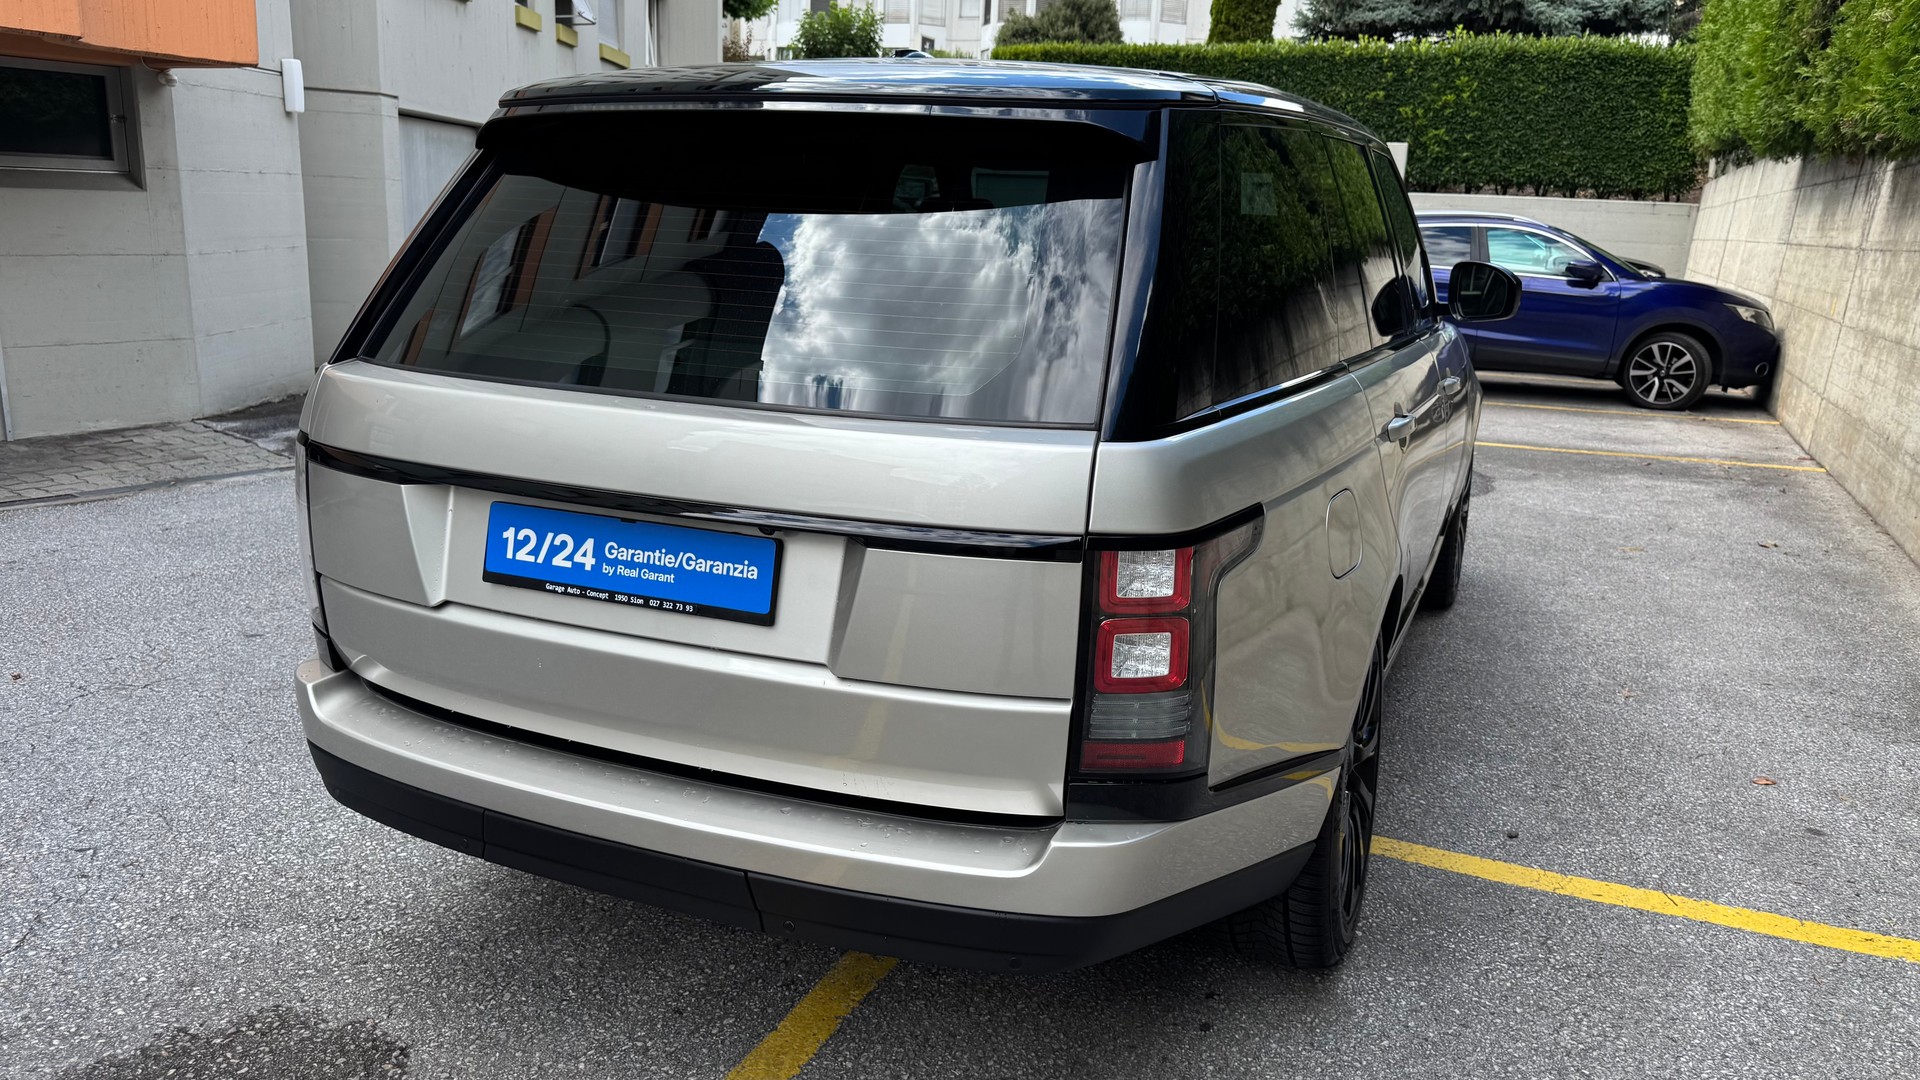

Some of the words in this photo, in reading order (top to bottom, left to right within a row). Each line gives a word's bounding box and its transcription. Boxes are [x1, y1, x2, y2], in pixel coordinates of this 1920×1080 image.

[502, 526, 596, 571] 12/24
[604, 541, 758, 580] Garantie/Garanzia
[602, 562, 616, 577] by
[616, 564, 639, 578] Real
[640, 568, 675, 584] Garant
[545, 582, 565, 594] Garage
[566, 586, 581, 595] Auto
[586, 589, 609, 600] Concept
[614, 593, 629, 603] 1950
[630, 596, 644, 605] Sion
[649, 599, 661, 607] 027
[662, 601, 674, 610] 322
[675, 603, 684, 611] 73
[685, 604, 694, 613] 93
